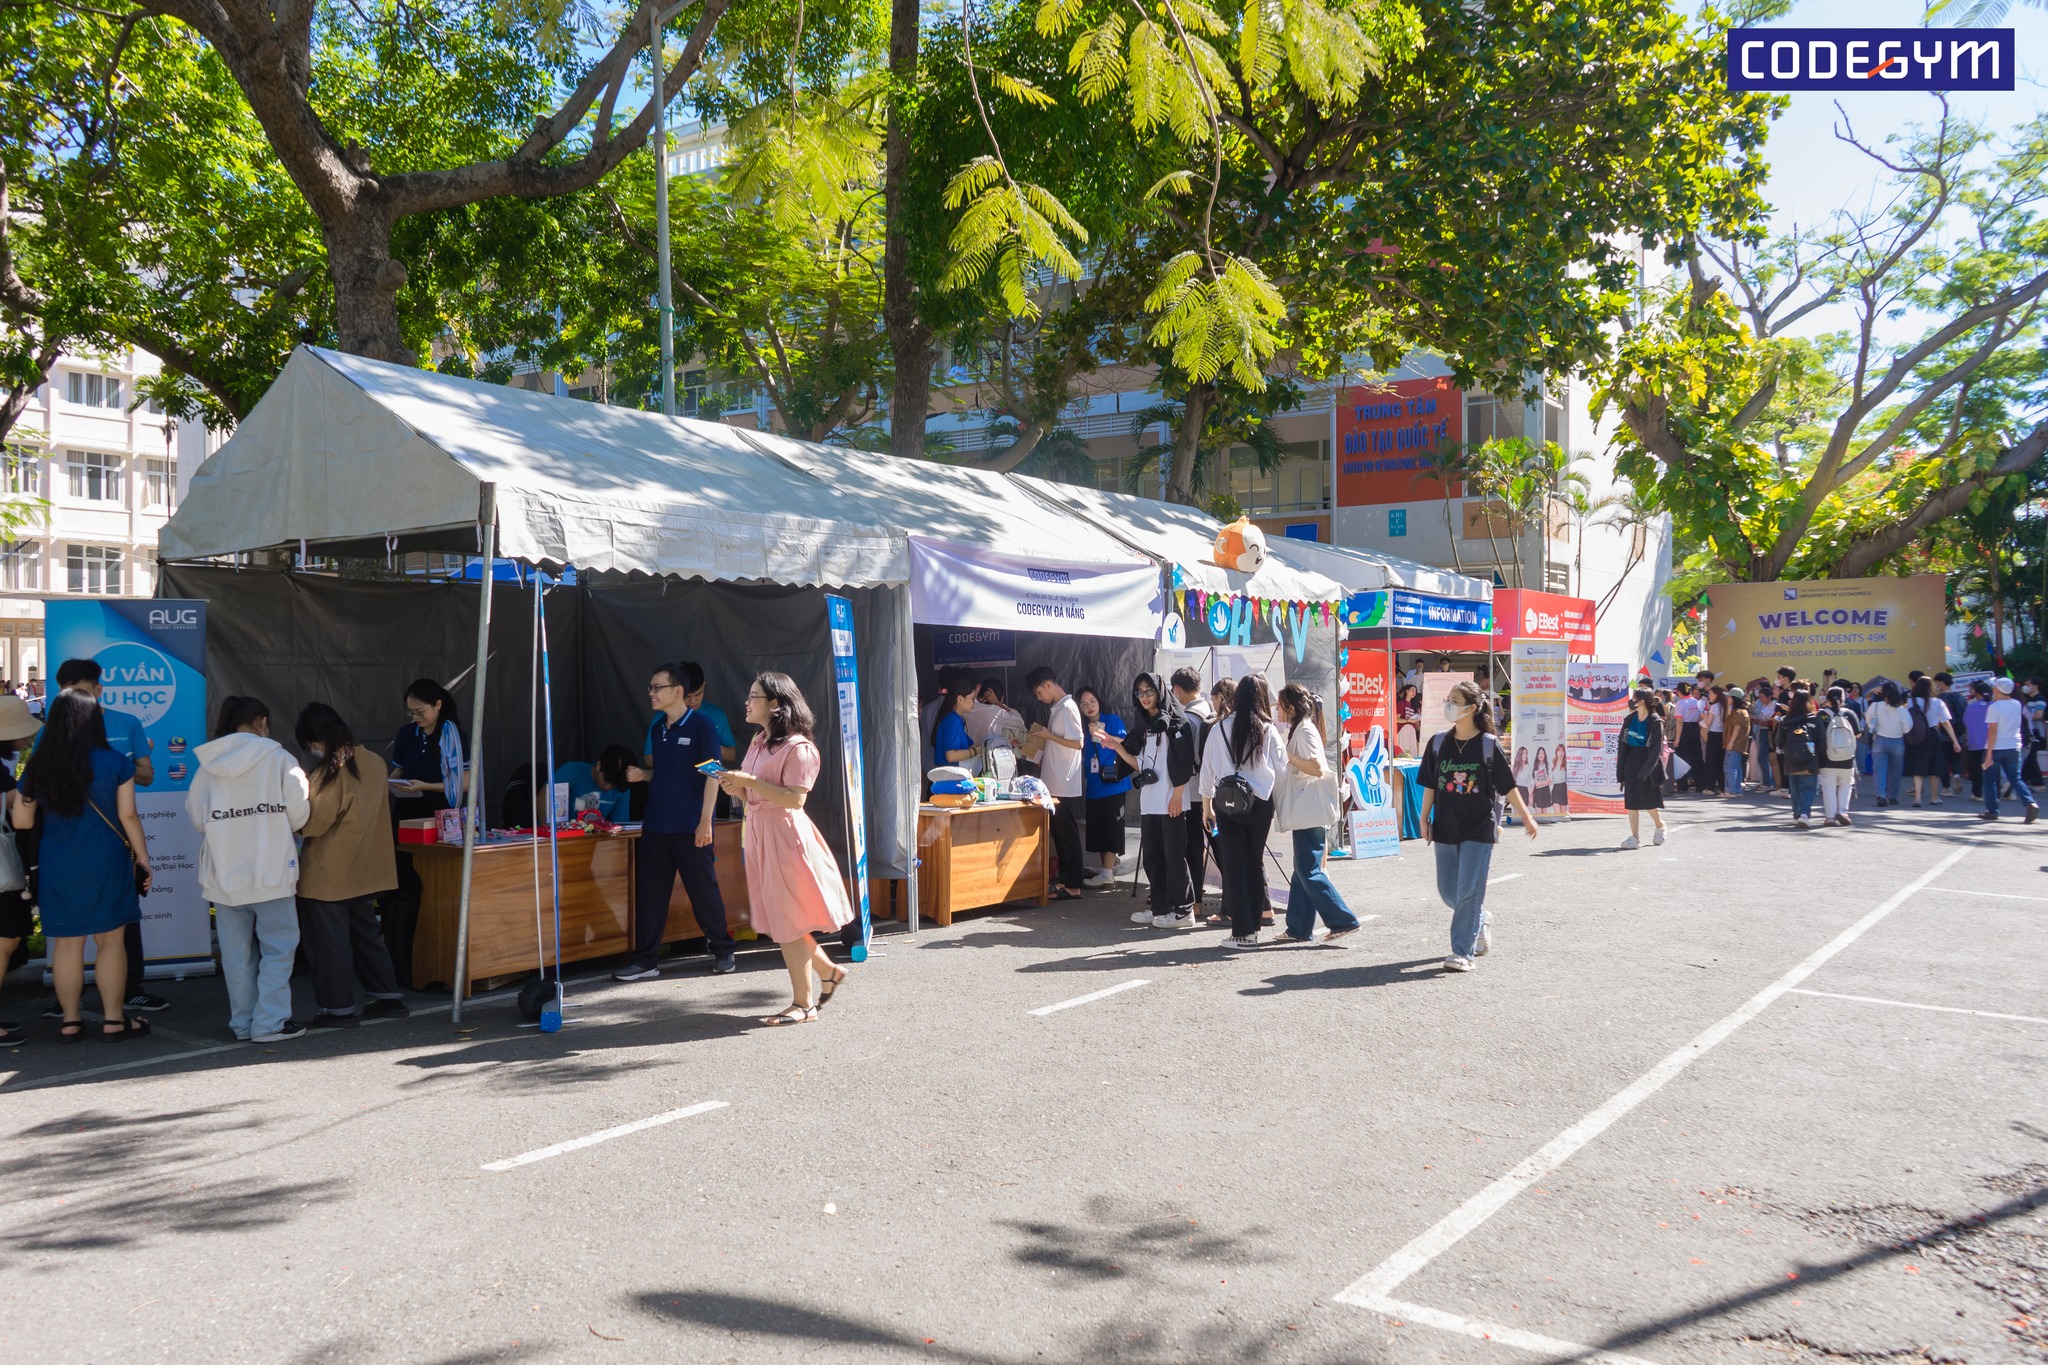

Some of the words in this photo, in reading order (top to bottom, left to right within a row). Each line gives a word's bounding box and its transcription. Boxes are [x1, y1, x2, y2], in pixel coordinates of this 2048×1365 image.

[1355, 402, 1401, 421] TRUNG
[1406, 395, 1437, 415] TÂM
[1344, 426, 1367, 455] ĐÀO
[1370, 428, 1393, 455] TẠO
[1397, 418, 1429, 452] QUỐC
[1374, 457, 1416, 472] INTERNATIONAL
[1029, 570, 1070, 584] CODEGYM
[1395, 593, 1420, 604] International
[1016, 602, 1052, 617] CODEGYM
[1054, 604, 1064, 618] ĐÀ
[1395, 604, 1416, 614] Education
[1428, 606, 1477, 624] INFORMATION
[149, 610, 197, 624] AUG
[1394, 614, 1414, 626] Programs
[1538, 612, 1559, 630] EBest
[1758, 609, 1888, 630] WELCOME
[948, 630, 1000, 644] CODEGYM
[1760, 636, 1778, 645] ALL
[1781, 636, 1806, 644] NEW
[1808, 634, 1864, 644] STUDENTS
[1866, 632, 1888, 642] 49K
[100, 666, 118, 682] Ư
[120, 661, 165, 682] VẤN
[1349, 673, 1384, 695] EBest
[122, 690, 167, 709] HỌC
[1568, 714, 1590, 723] BEST
[1593, 715, 1625, 723] ENGLIS
[1440, 759, 1480, 773] Uncover
[147, 810, 176, 819] nghiệp
